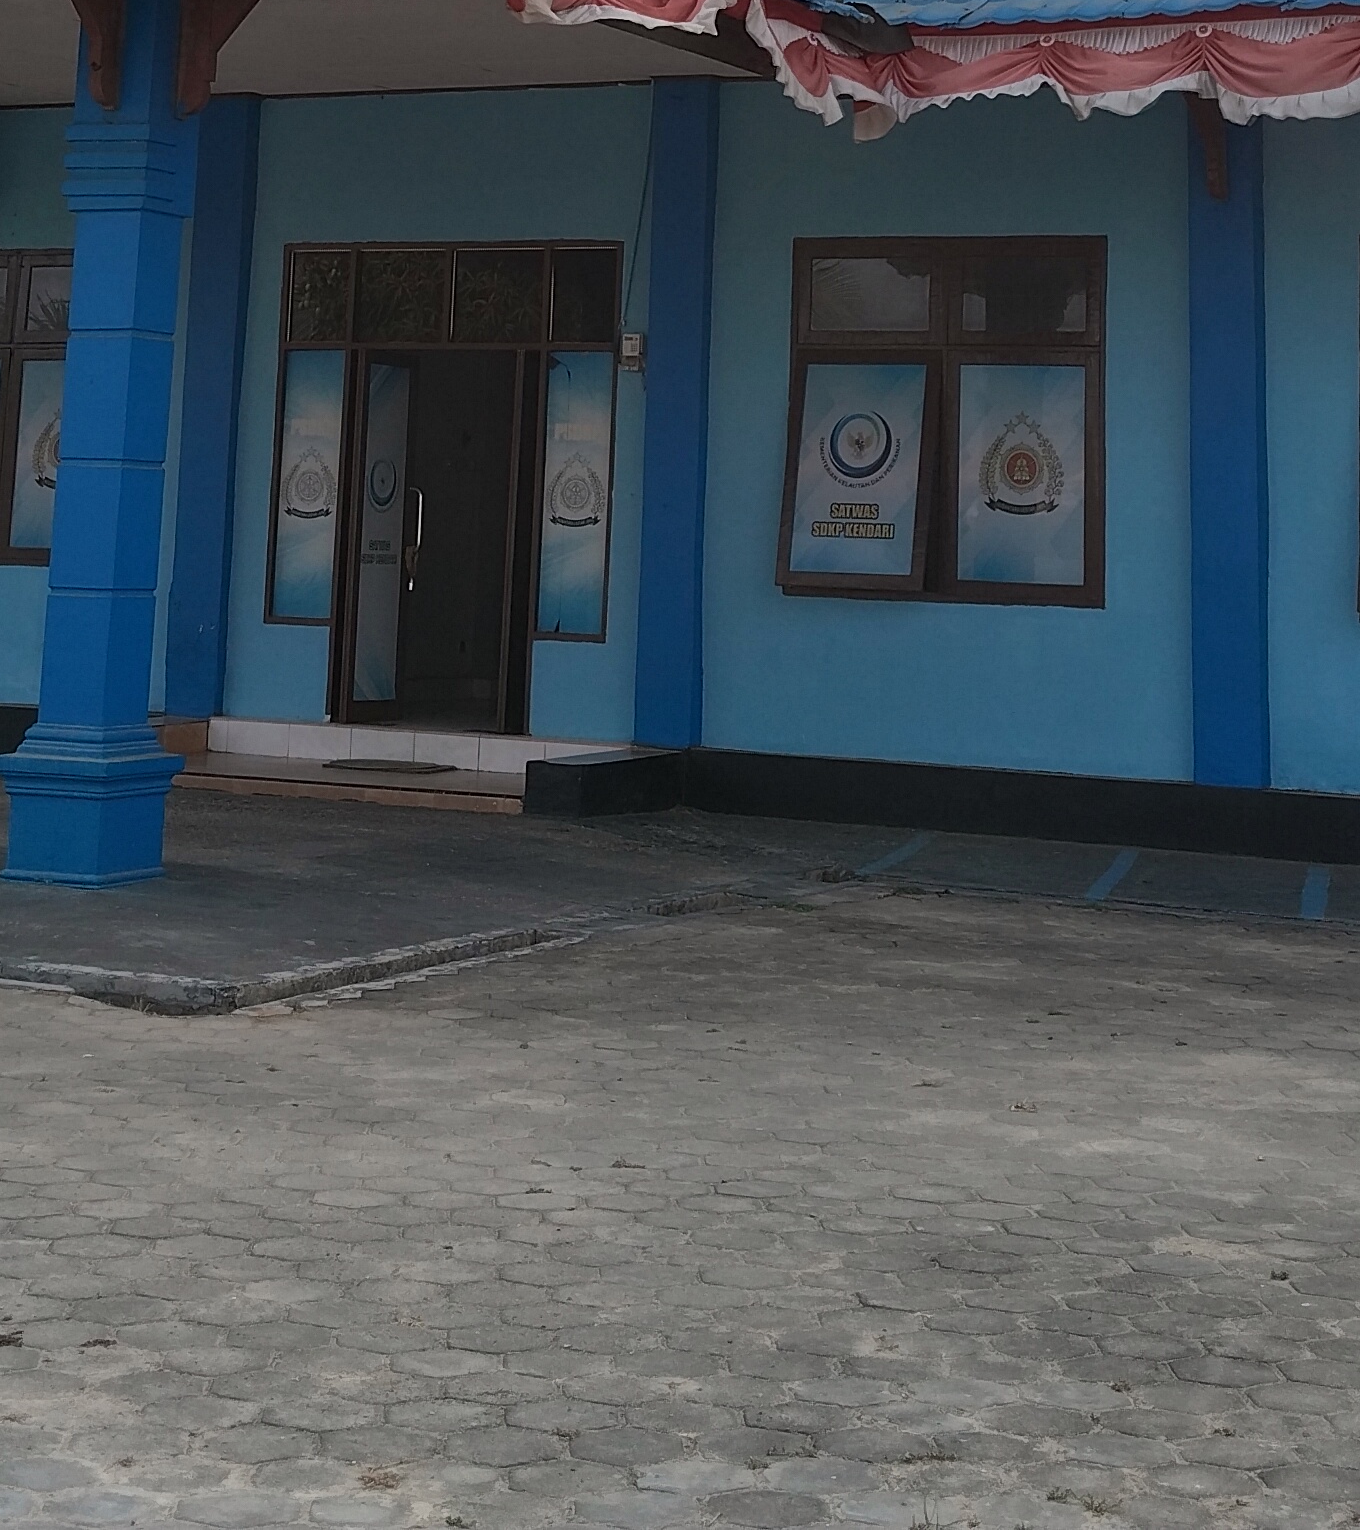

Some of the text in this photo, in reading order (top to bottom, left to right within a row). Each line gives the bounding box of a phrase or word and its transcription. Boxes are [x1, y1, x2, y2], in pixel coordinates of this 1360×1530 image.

[830, 502, 879, 520] SATWAS
[811, 521, 895, 539] SDKP KENDARI
